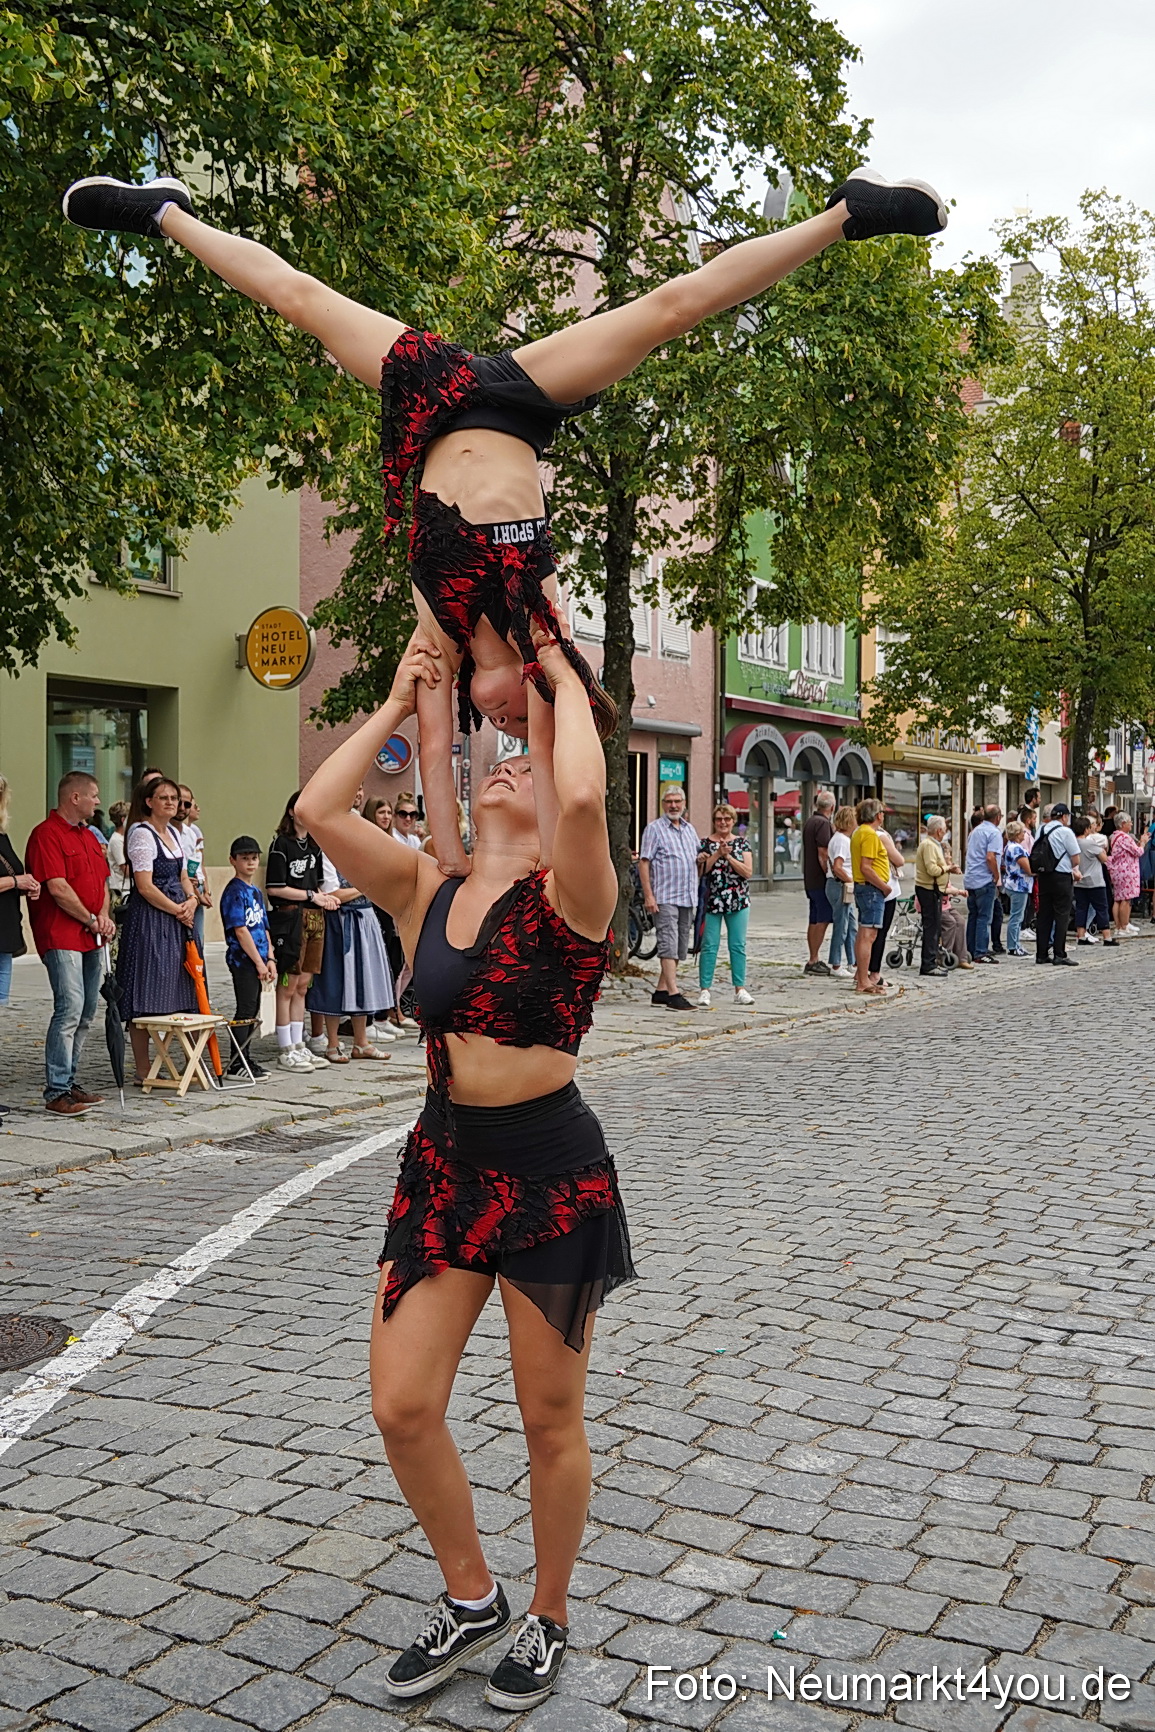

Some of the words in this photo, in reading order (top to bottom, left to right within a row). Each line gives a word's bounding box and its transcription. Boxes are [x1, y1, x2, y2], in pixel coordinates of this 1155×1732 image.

[492, 521, 535, 545] SPORT
[261, 630, 302, 642] HOTEL
[261, 644, 286, 654] NEU
[261, 655, 302, 667] MARKT
